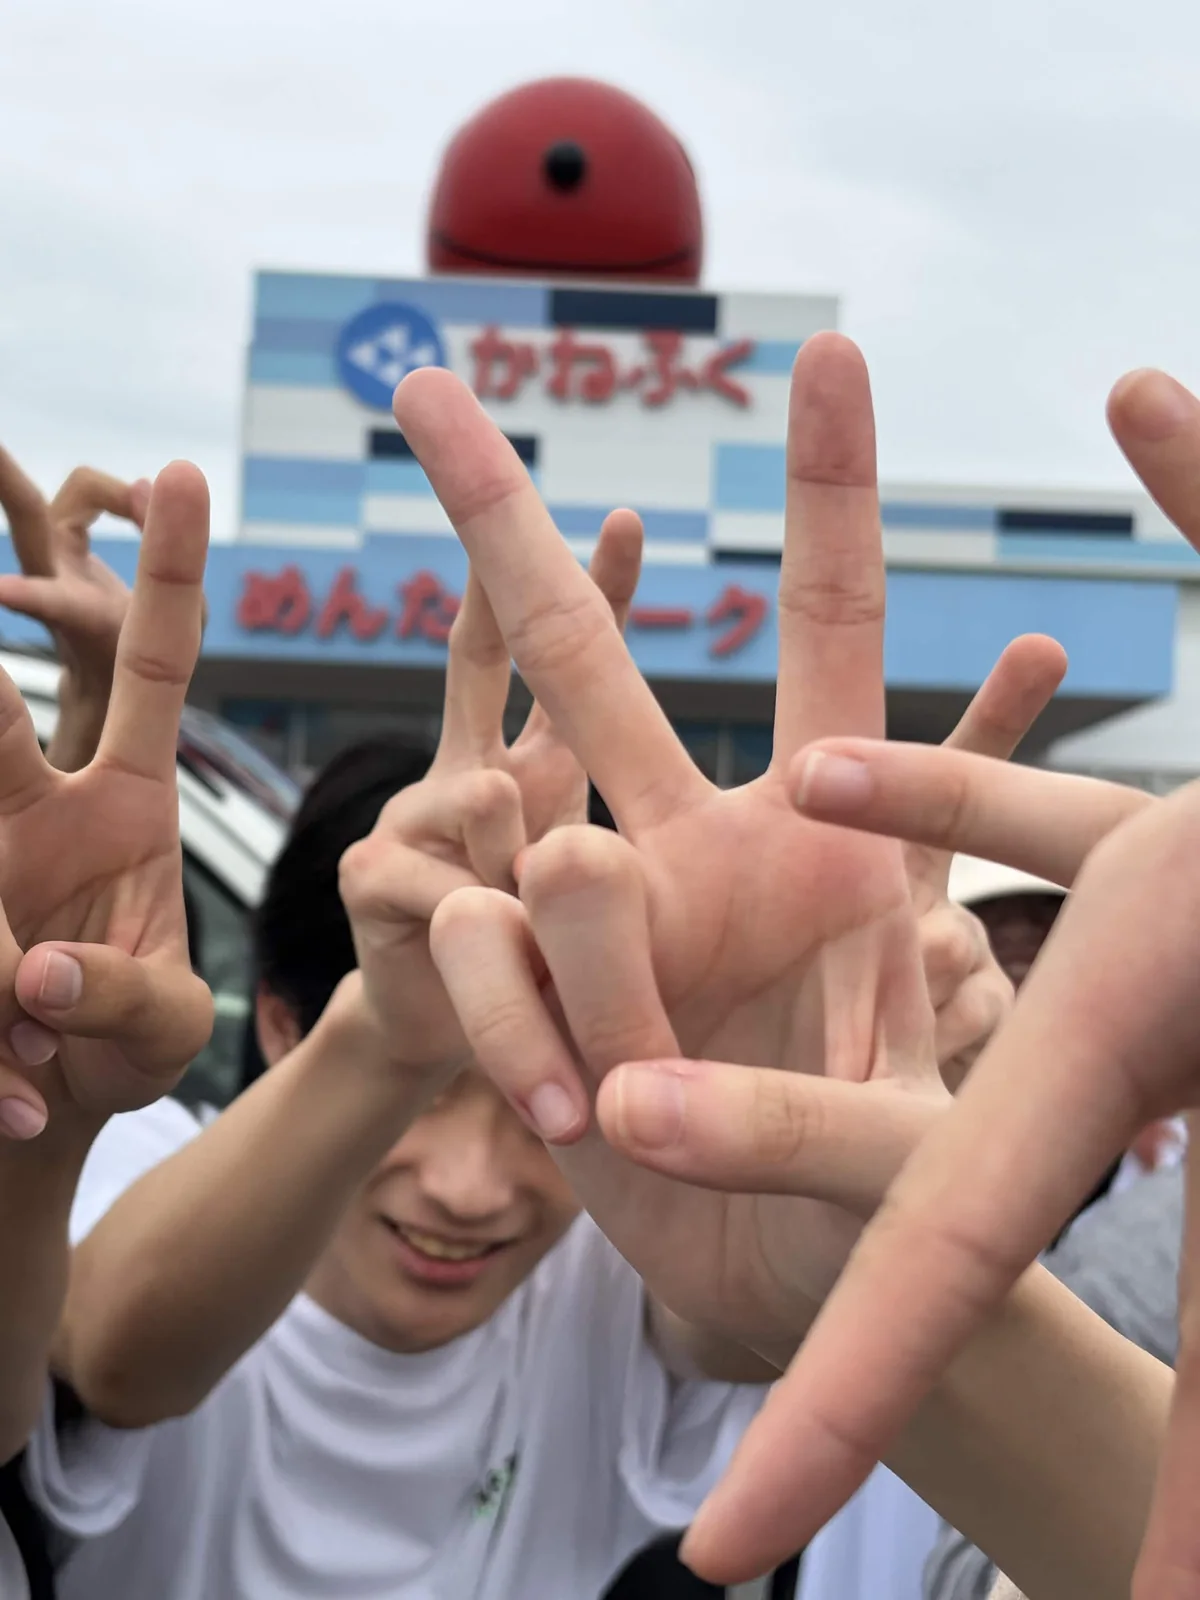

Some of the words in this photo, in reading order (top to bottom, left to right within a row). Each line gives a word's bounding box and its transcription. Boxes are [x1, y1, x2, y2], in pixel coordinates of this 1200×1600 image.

[470, 327, 755, 407] かねふく
[237, 564, 768, 655] めんたーク
